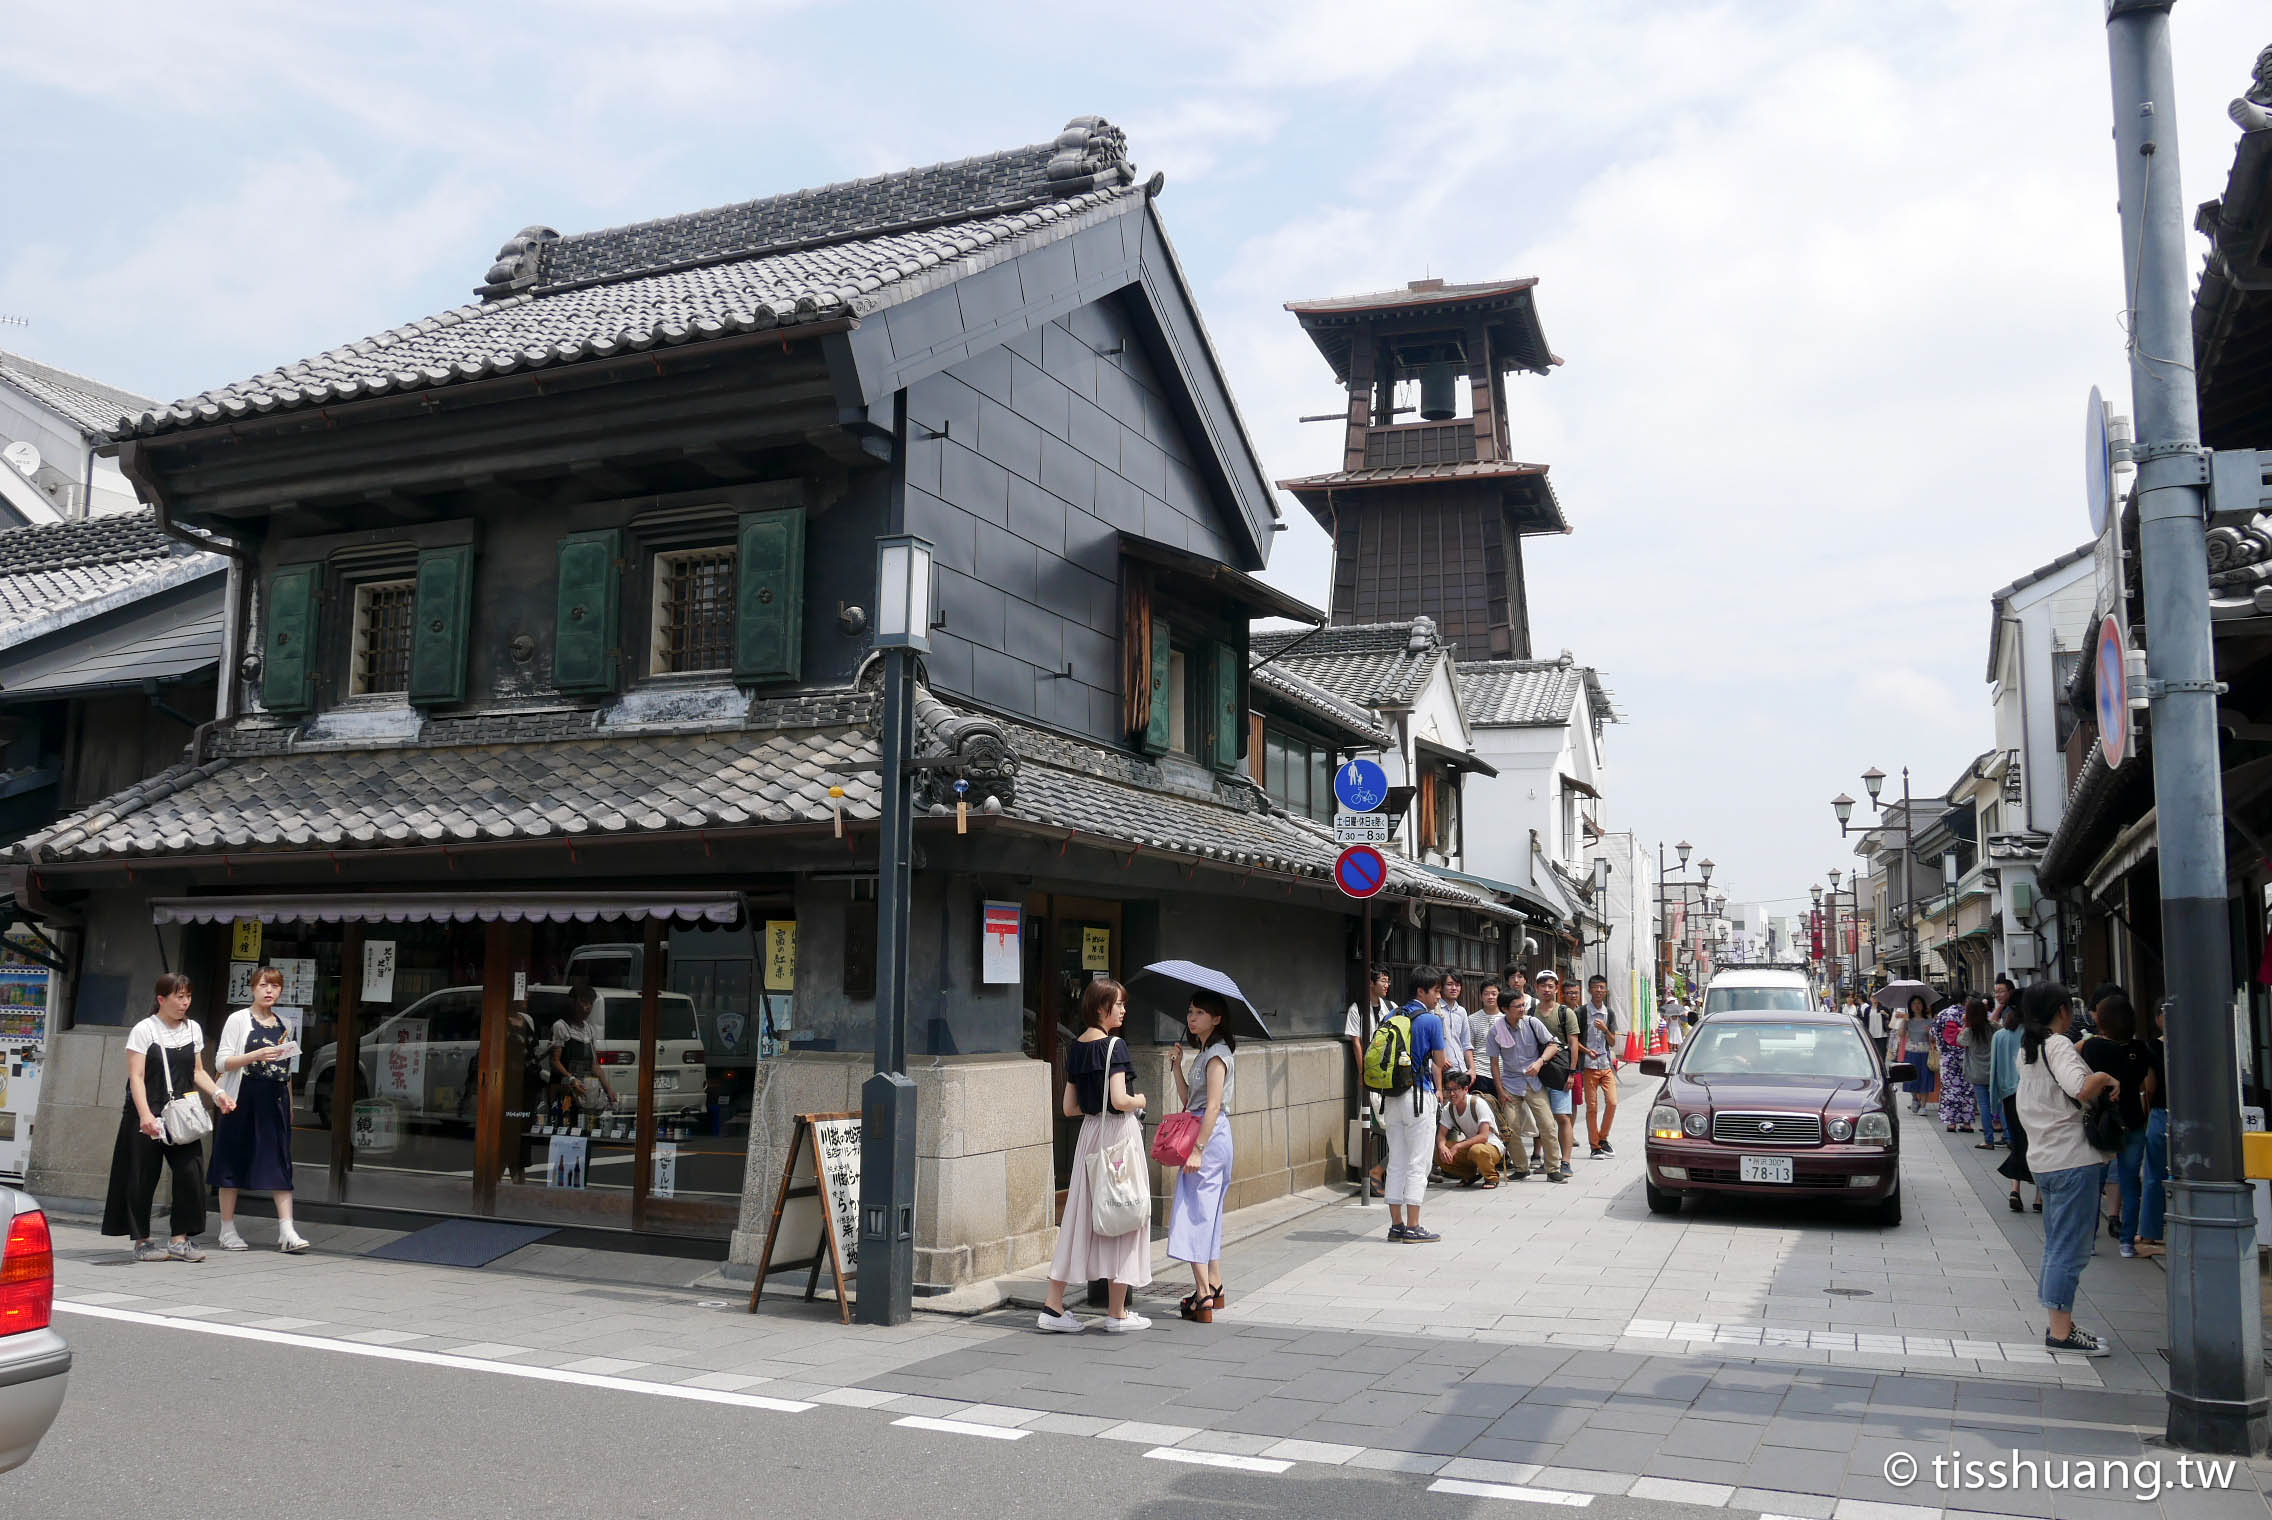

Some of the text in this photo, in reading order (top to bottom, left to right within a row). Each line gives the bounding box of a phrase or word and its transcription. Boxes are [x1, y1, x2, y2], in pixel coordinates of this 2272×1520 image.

[355, 1116, 375, 1147] 鏡山
[1768, 1158, 1782, 1167] 300
[1752, 1166, 1790, 1181] 78-13
